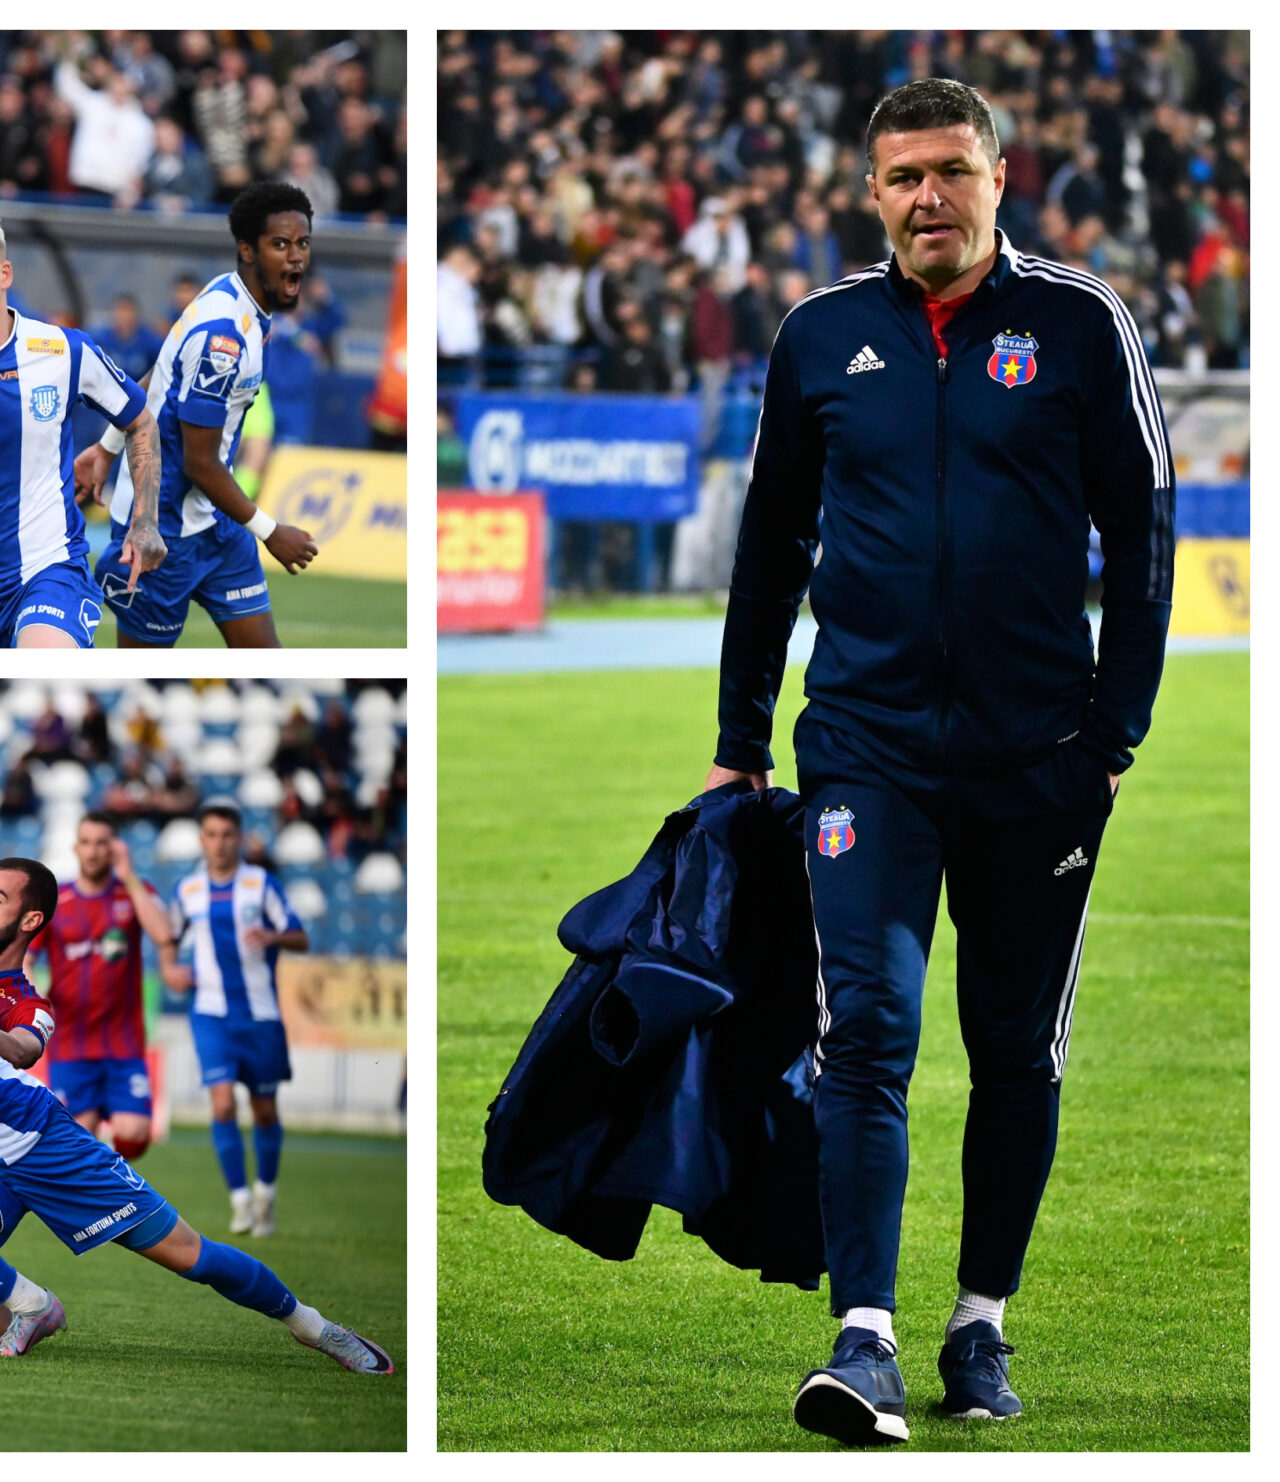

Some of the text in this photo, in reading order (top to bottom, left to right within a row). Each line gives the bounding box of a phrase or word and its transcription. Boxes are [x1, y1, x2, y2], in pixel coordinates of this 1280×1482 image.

[996, 336, 1035, 350] STEAUA
[846, 360, 886, 375] adidas
[37, 604, 65, 620] SPORTS
[85, 1214, 116, 1239] FORTUNA
[112, 1201, 138, 1223] SPORTS
